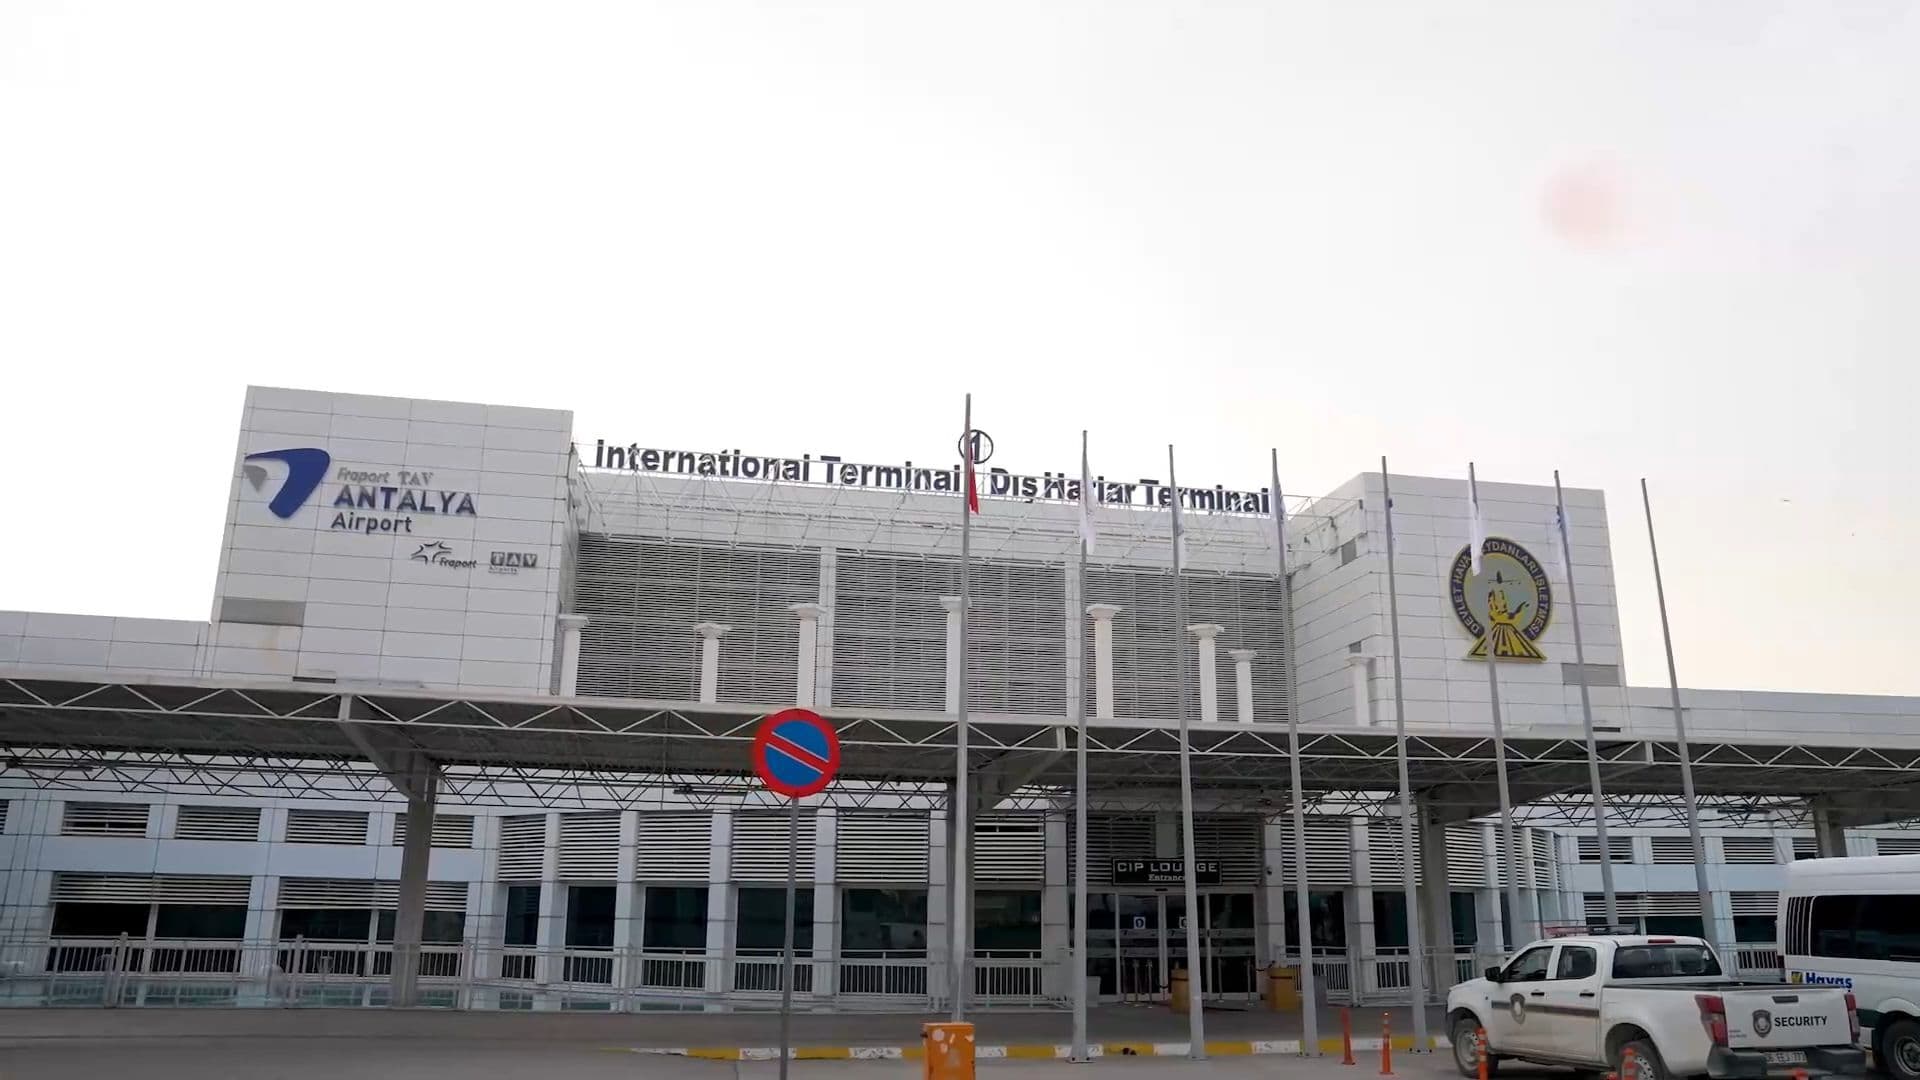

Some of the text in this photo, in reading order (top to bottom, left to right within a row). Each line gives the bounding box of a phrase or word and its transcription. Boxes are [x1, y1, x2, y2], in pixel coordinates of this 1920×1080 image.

[595, 439, 960, 493] International Terminal
[337, 467, 434, 486] Fraport TAV
[991, 467, 1270, 514] Dış Halar Terminal
[334, 484, 477, 515] ANTALYA
[331, 511, 412, 535] Airport
[440, 556, 478, 570] Fraport
[491, 552, 537, 568] TAV
[1117, 862, 1218, 873] CIP LOUGE
[1148, 873, 1186, 881] Entranc
[1774, 1015, 1828, 1027] SECURITY
